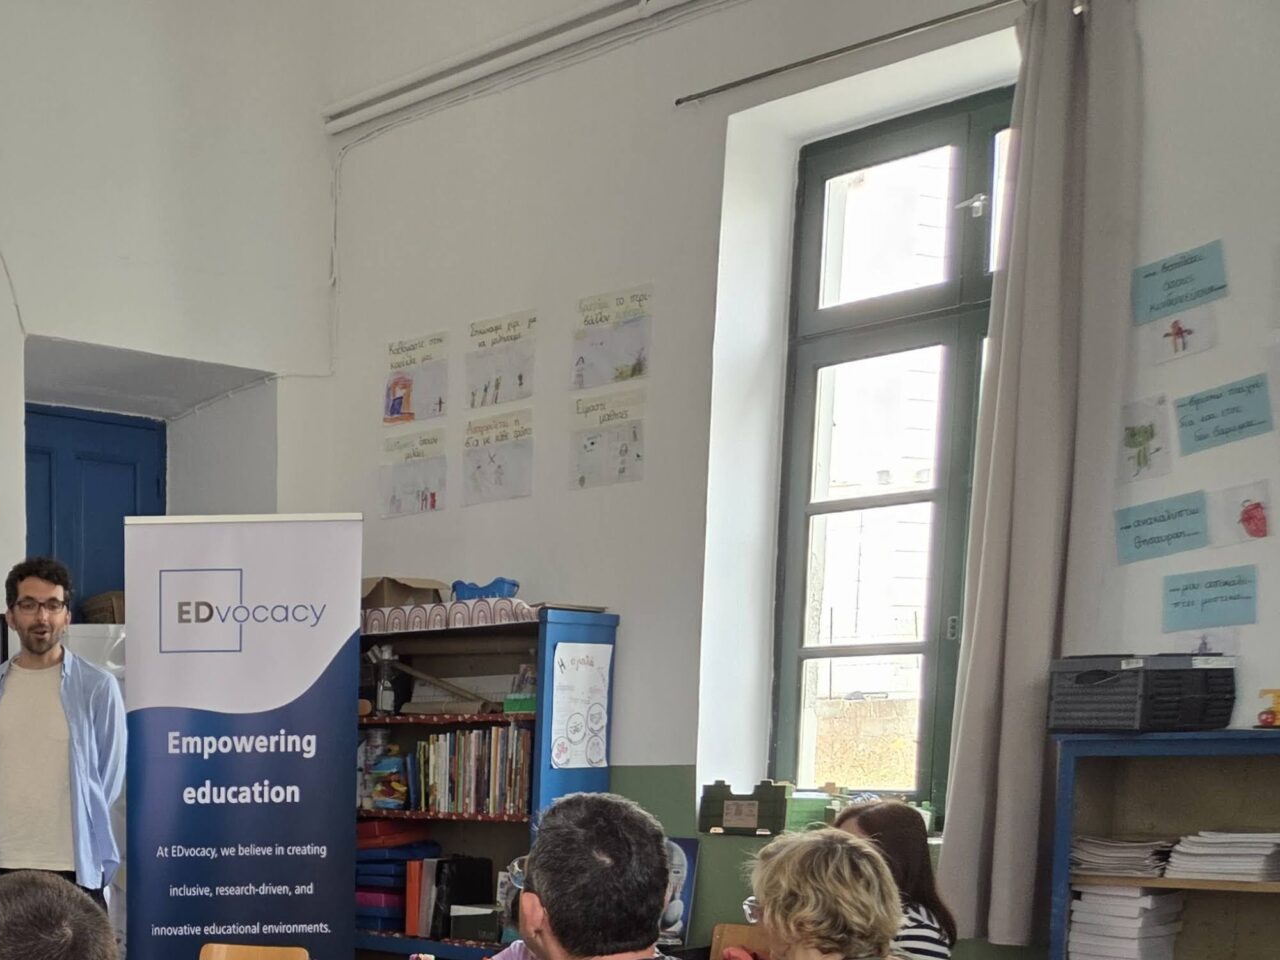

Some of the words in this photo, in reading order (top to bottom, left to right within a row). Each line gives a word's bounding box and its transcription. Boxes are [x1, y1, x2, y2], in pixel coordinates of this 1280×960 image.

[178, 601, 326, 627] EDvocacy
[168, 729, 317, 760] Empowering
[183, 779, 300, 804] education
[156, 846, 169, 858] At
[171, 845, 218, 859] EDvocacy,
[220, 847, 236, 857] we
[238, 843, 273, 856] believe
[275, 843, 285, 856] in
[287, 843, 327, 858] creating
[170, 885, 213, 897] inclusive,
[216, 883, 292, 897] research-driven,
[295, 883, 314, 894] and
[151, 924, 201, 936] innovative
[204, 923, 260, 935] educational
[262, 922, 331, 935] environments.
